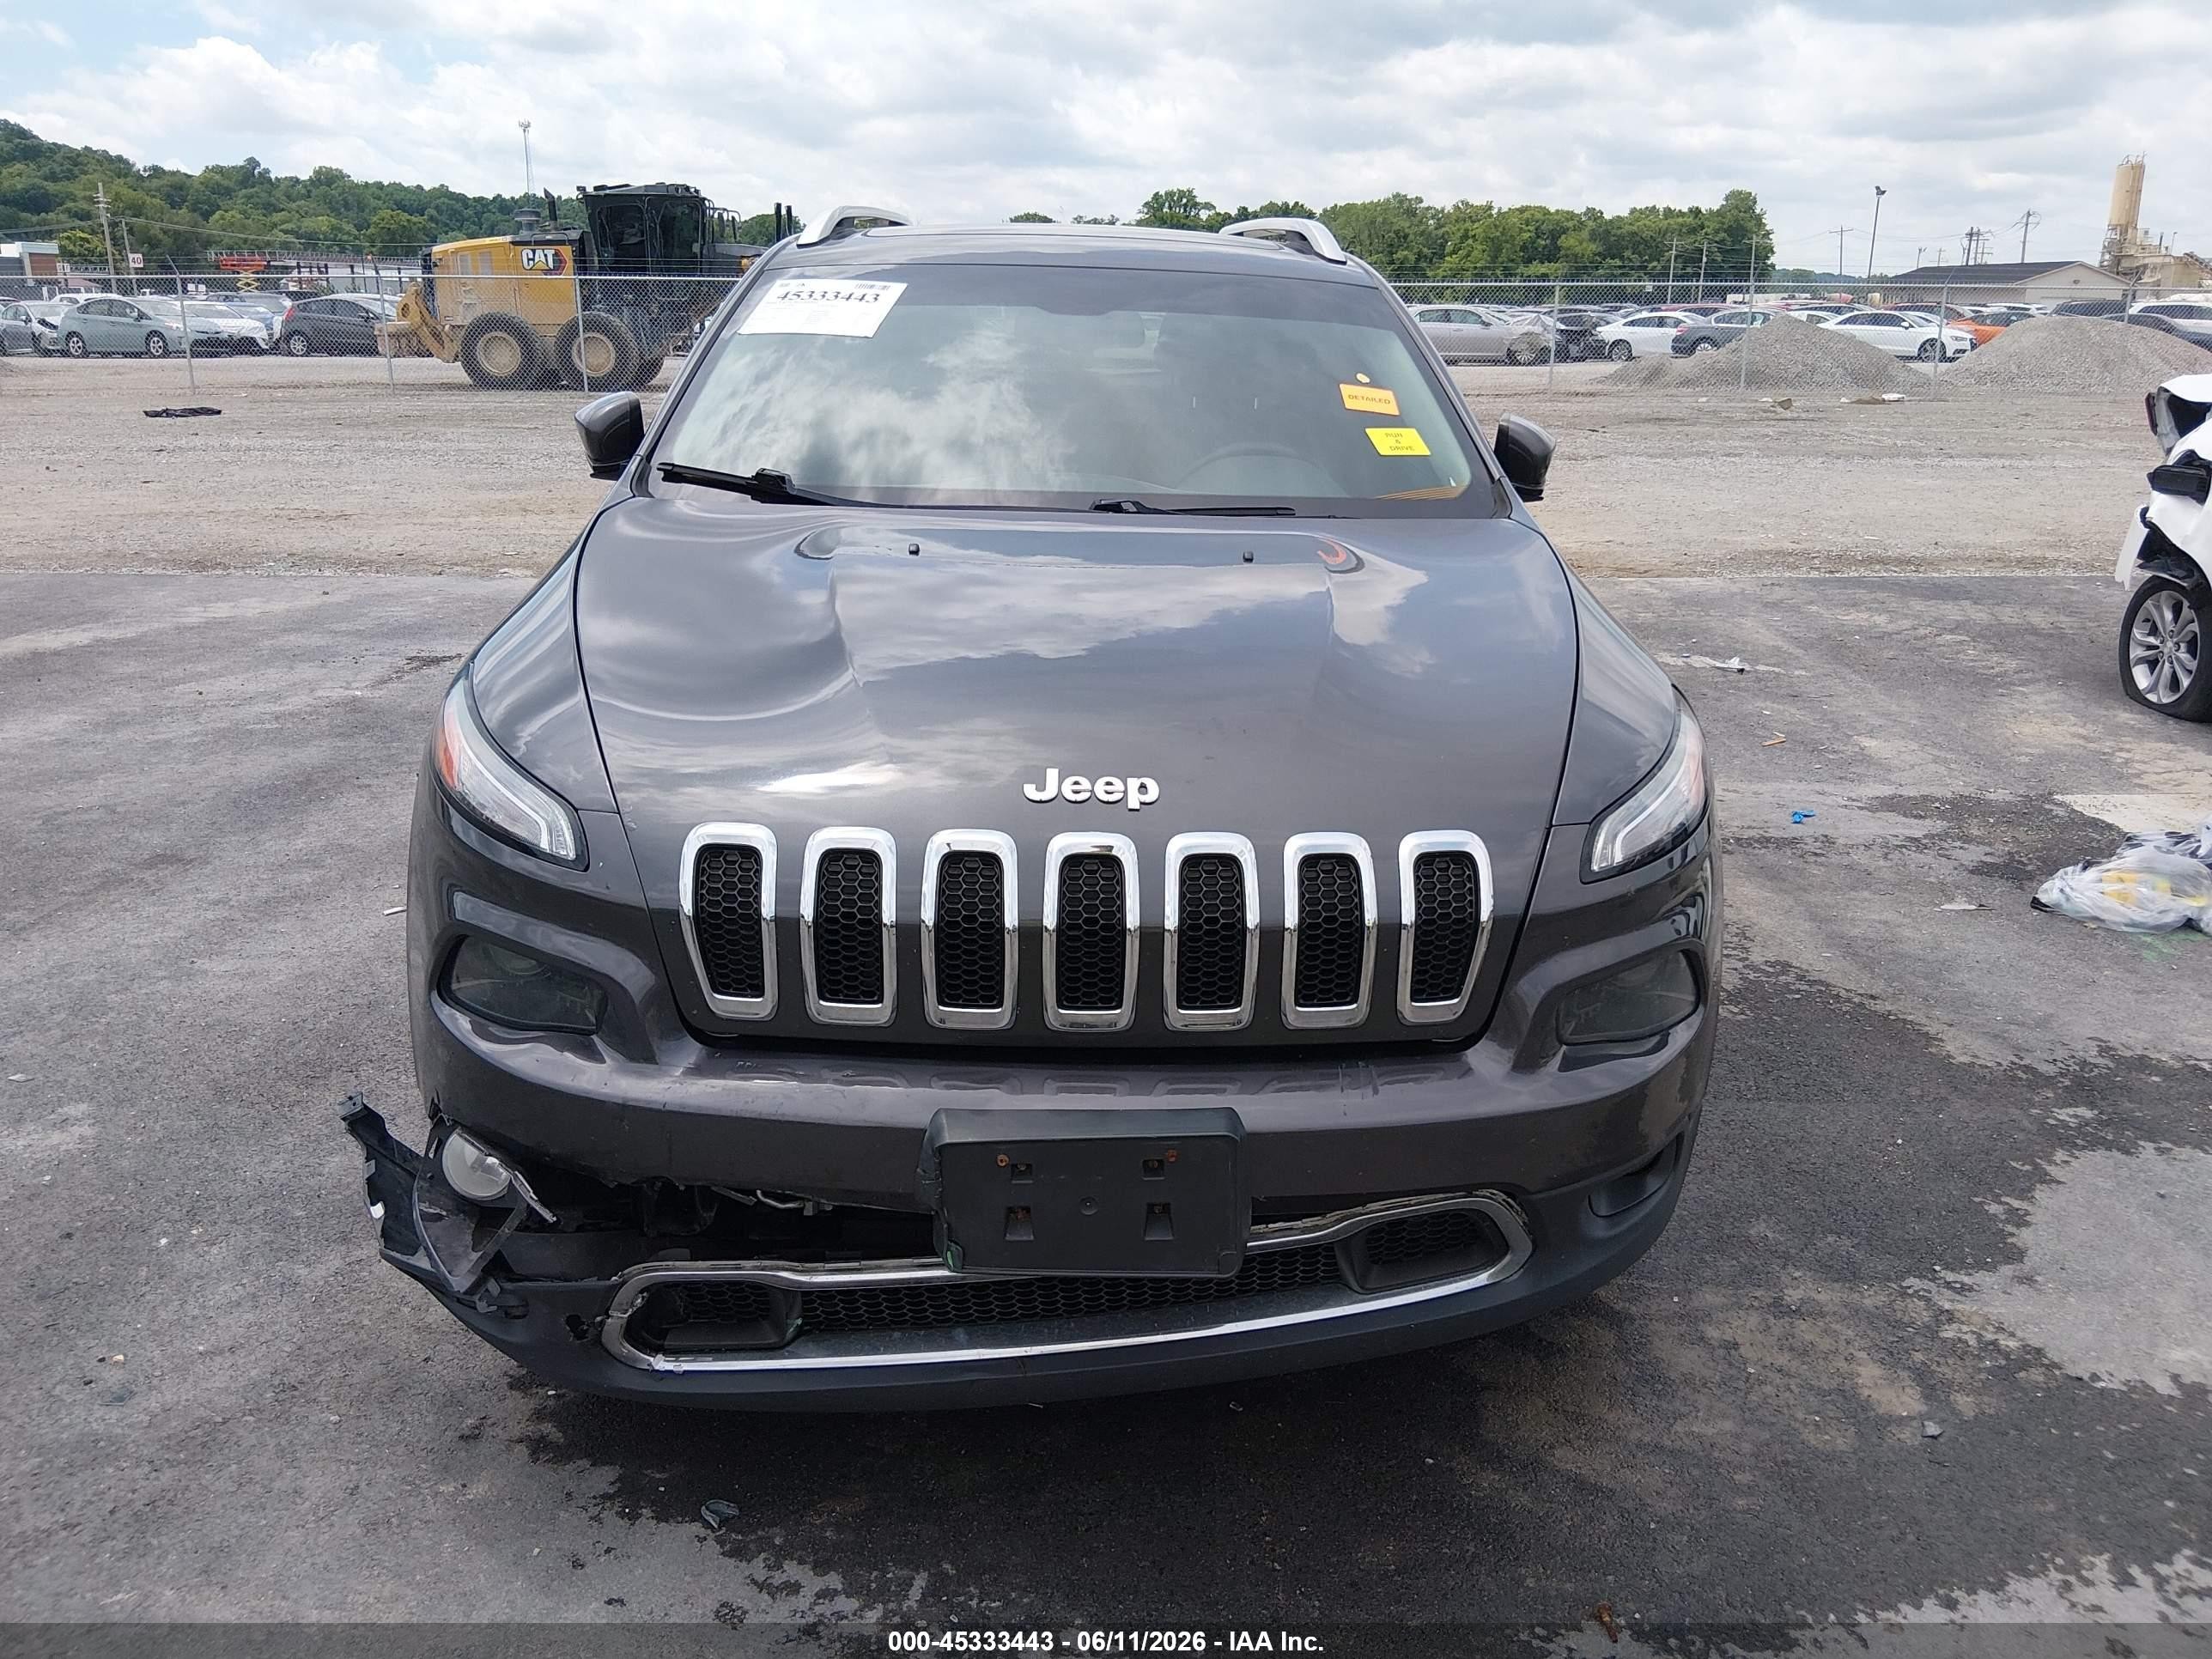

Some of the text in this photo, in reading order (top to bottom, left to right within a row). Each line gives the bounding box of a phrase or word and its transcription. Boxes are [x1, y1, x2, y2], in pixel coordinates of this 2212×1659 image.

[131, 257, 142, 265] 40
[521, 248, 556, 270] CAT
[777, 290, 881, 304] 45333443
[1347, 394, 1391, 404] DETAILED
[1023, 768, 1159, 811] Jeep
